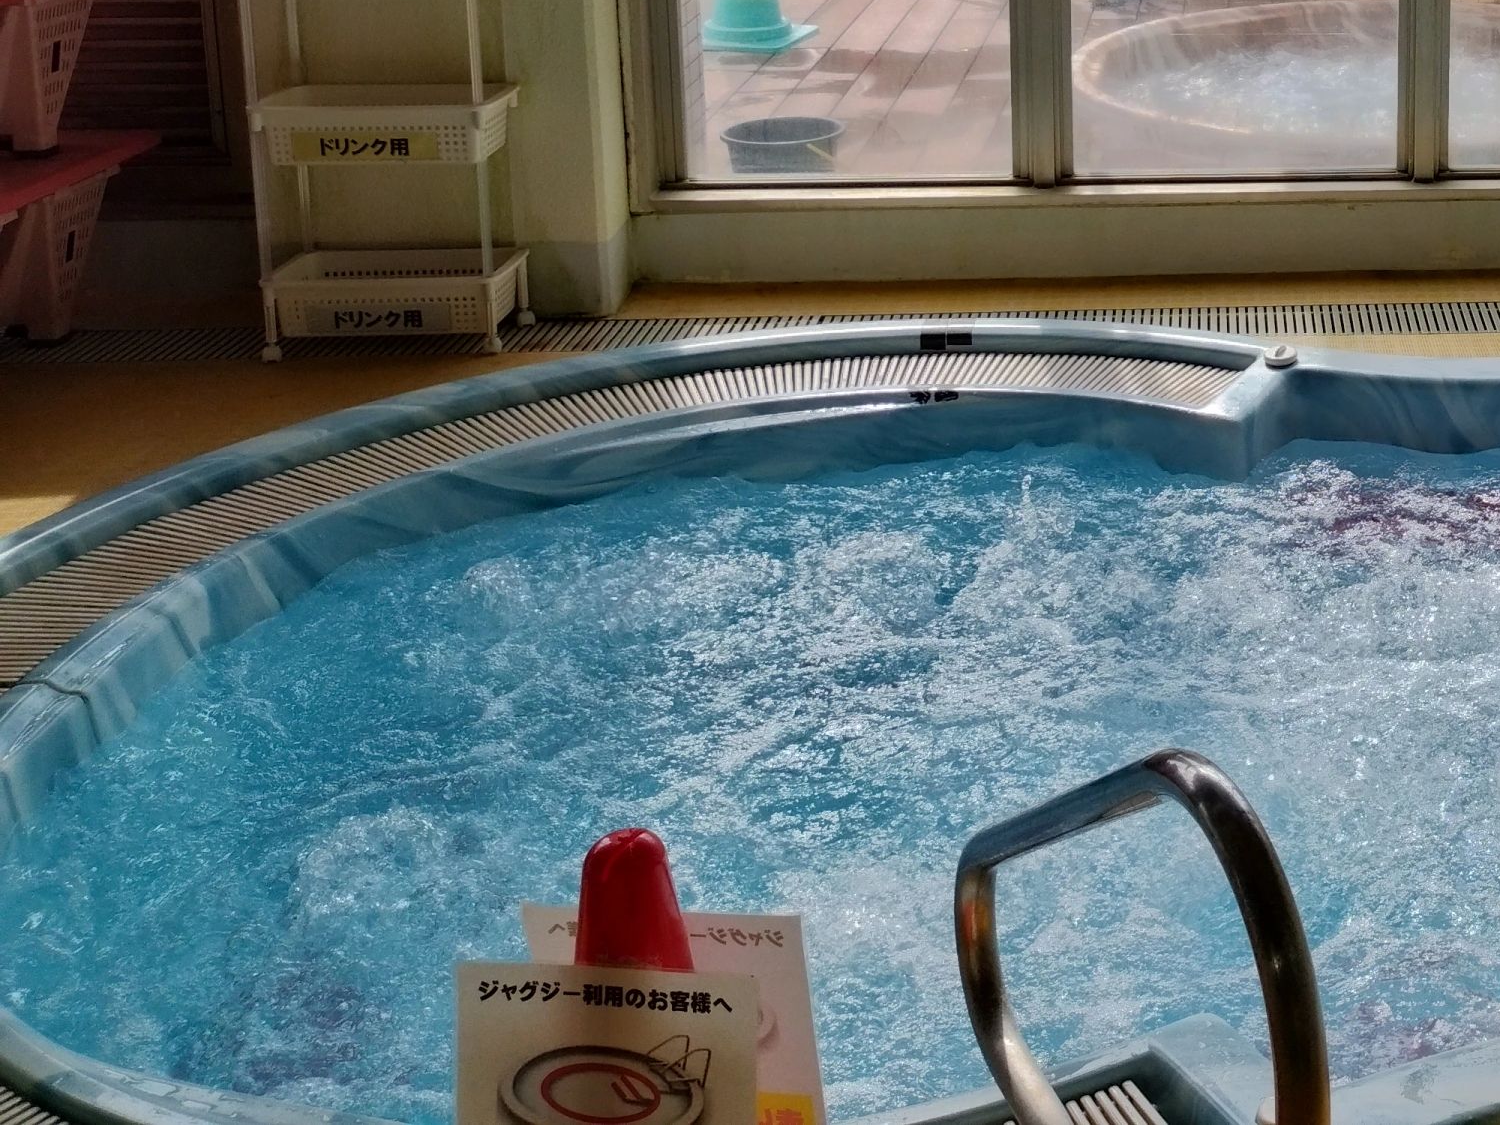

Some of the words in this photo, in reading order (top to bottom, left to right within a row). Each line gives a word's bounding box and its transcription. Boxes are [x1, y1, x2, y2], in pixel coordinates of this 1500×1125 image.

[320, 138, 410, 156] ドリンク用
[334, 310, 423, 329] ドリンク用
[478, 980, 733, 1014] ジャグジー利用のお客様へ
